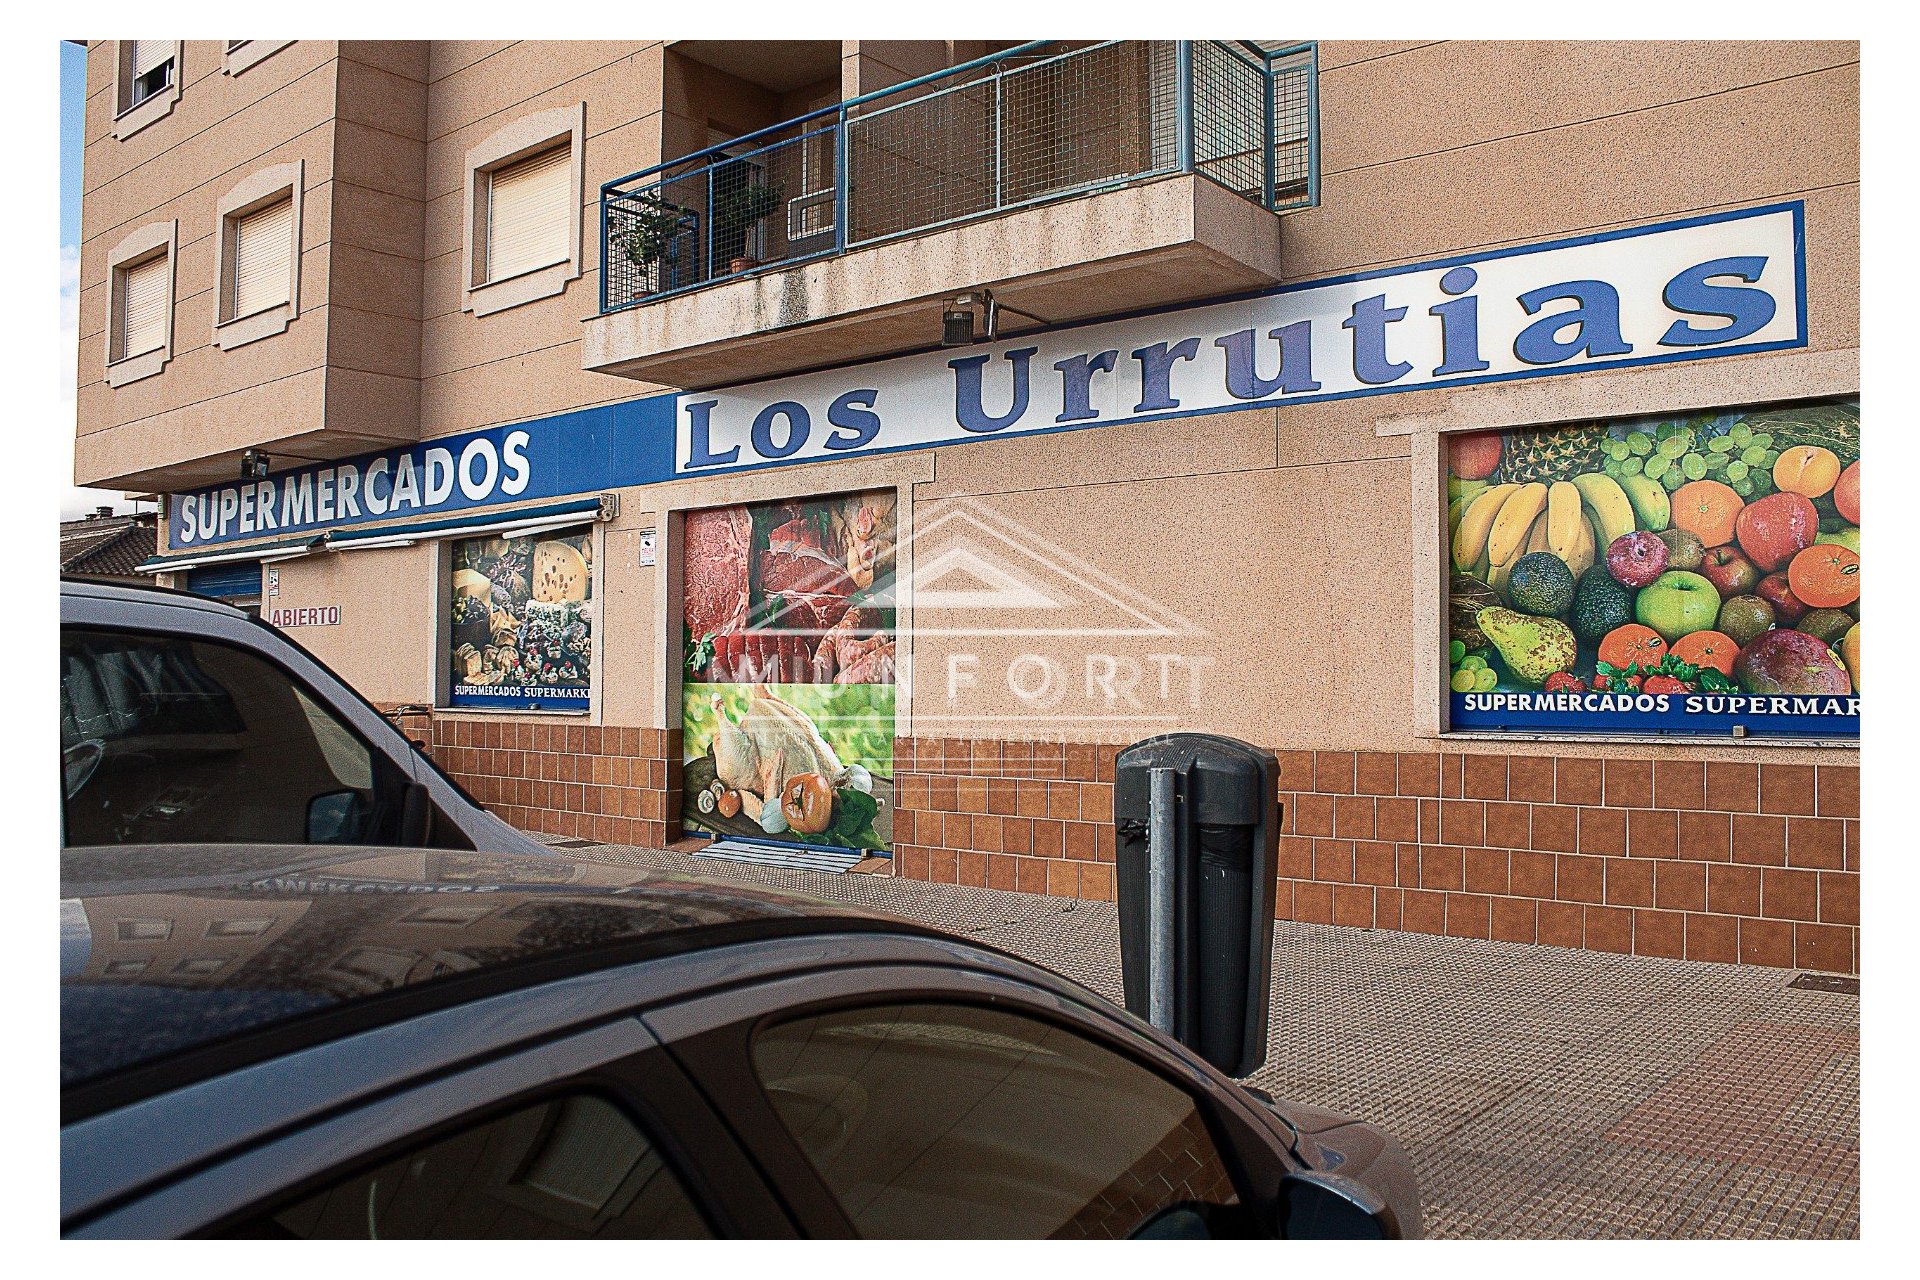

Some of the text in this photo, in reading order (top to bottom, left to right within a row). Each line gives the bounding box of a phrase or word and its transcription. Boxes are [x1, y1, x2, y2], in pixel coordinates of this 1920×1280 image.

[684, 255, 1778, 470] Los Urrutias
[180, 430, 531, 544] SUPERMERCADOS
[272, 606, 338, 627] ABIERTO
[454, 685, 521, 698] SUPERMERCADOS
[1464, 694, 1670, 713] SUPERMERCADOS
